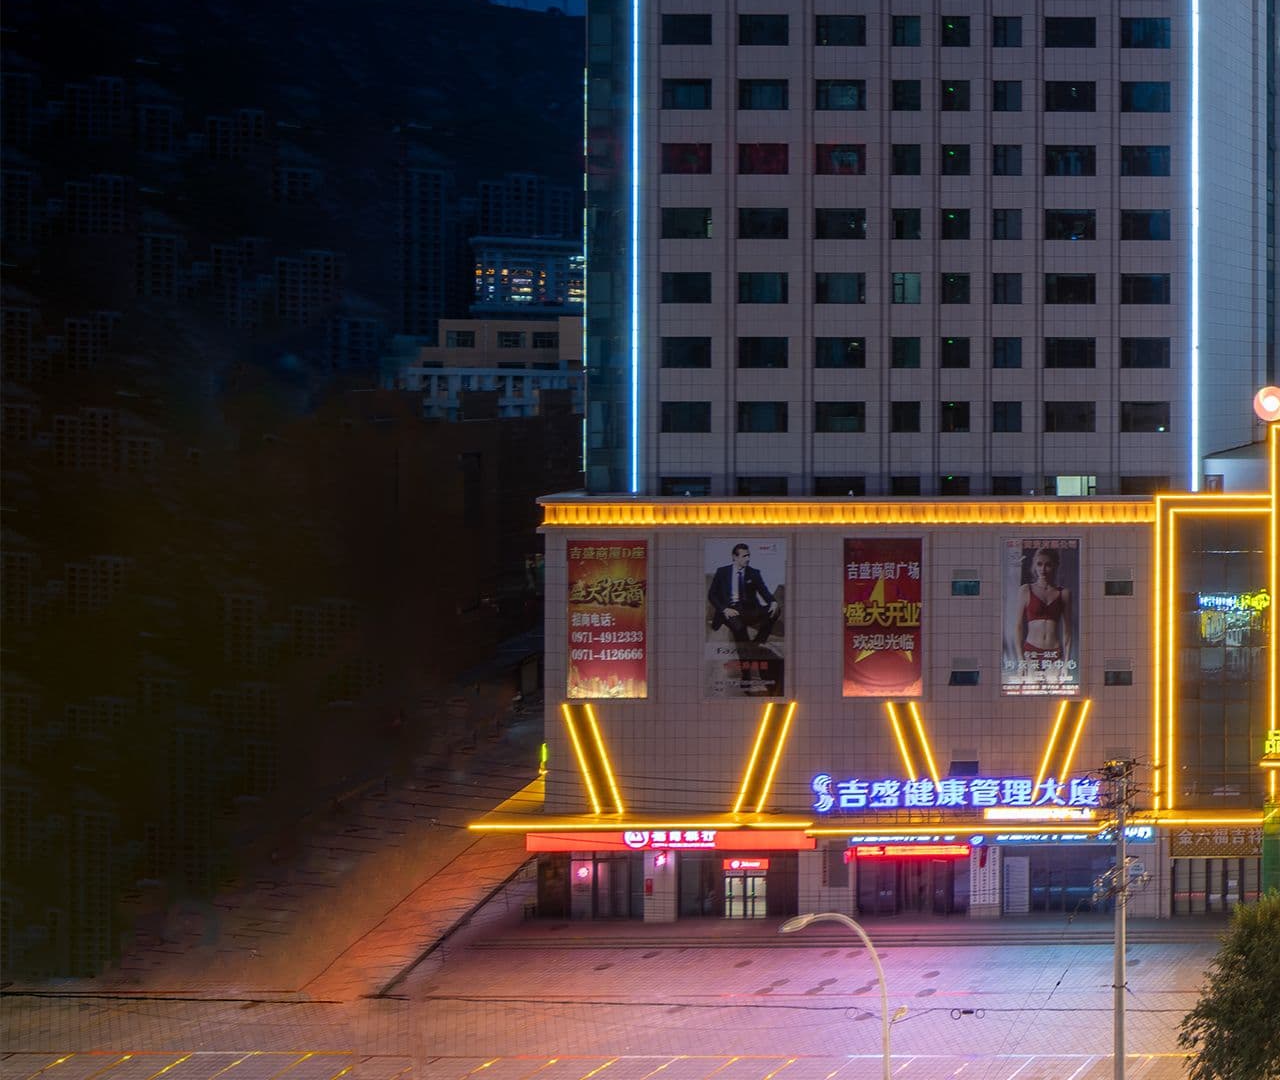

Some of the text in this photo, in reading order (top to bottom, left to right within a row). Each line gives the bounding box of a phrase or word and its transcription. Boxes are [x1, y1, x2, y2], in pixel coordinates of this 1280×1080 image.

[847, 562, 920, 580] 吉盛商贸广场
[569, 578, 644, 604] 盛大招商
[846, 600, 921, 627] 盛大开业
[571, 631, 643, 643] 0971-4912333
[853, 634, 915, 650] 欢迎光临
[571, 648, 643, 661] 0971-4126666
[837, 778, 1101, 808] 吉盛健康管理大厦
